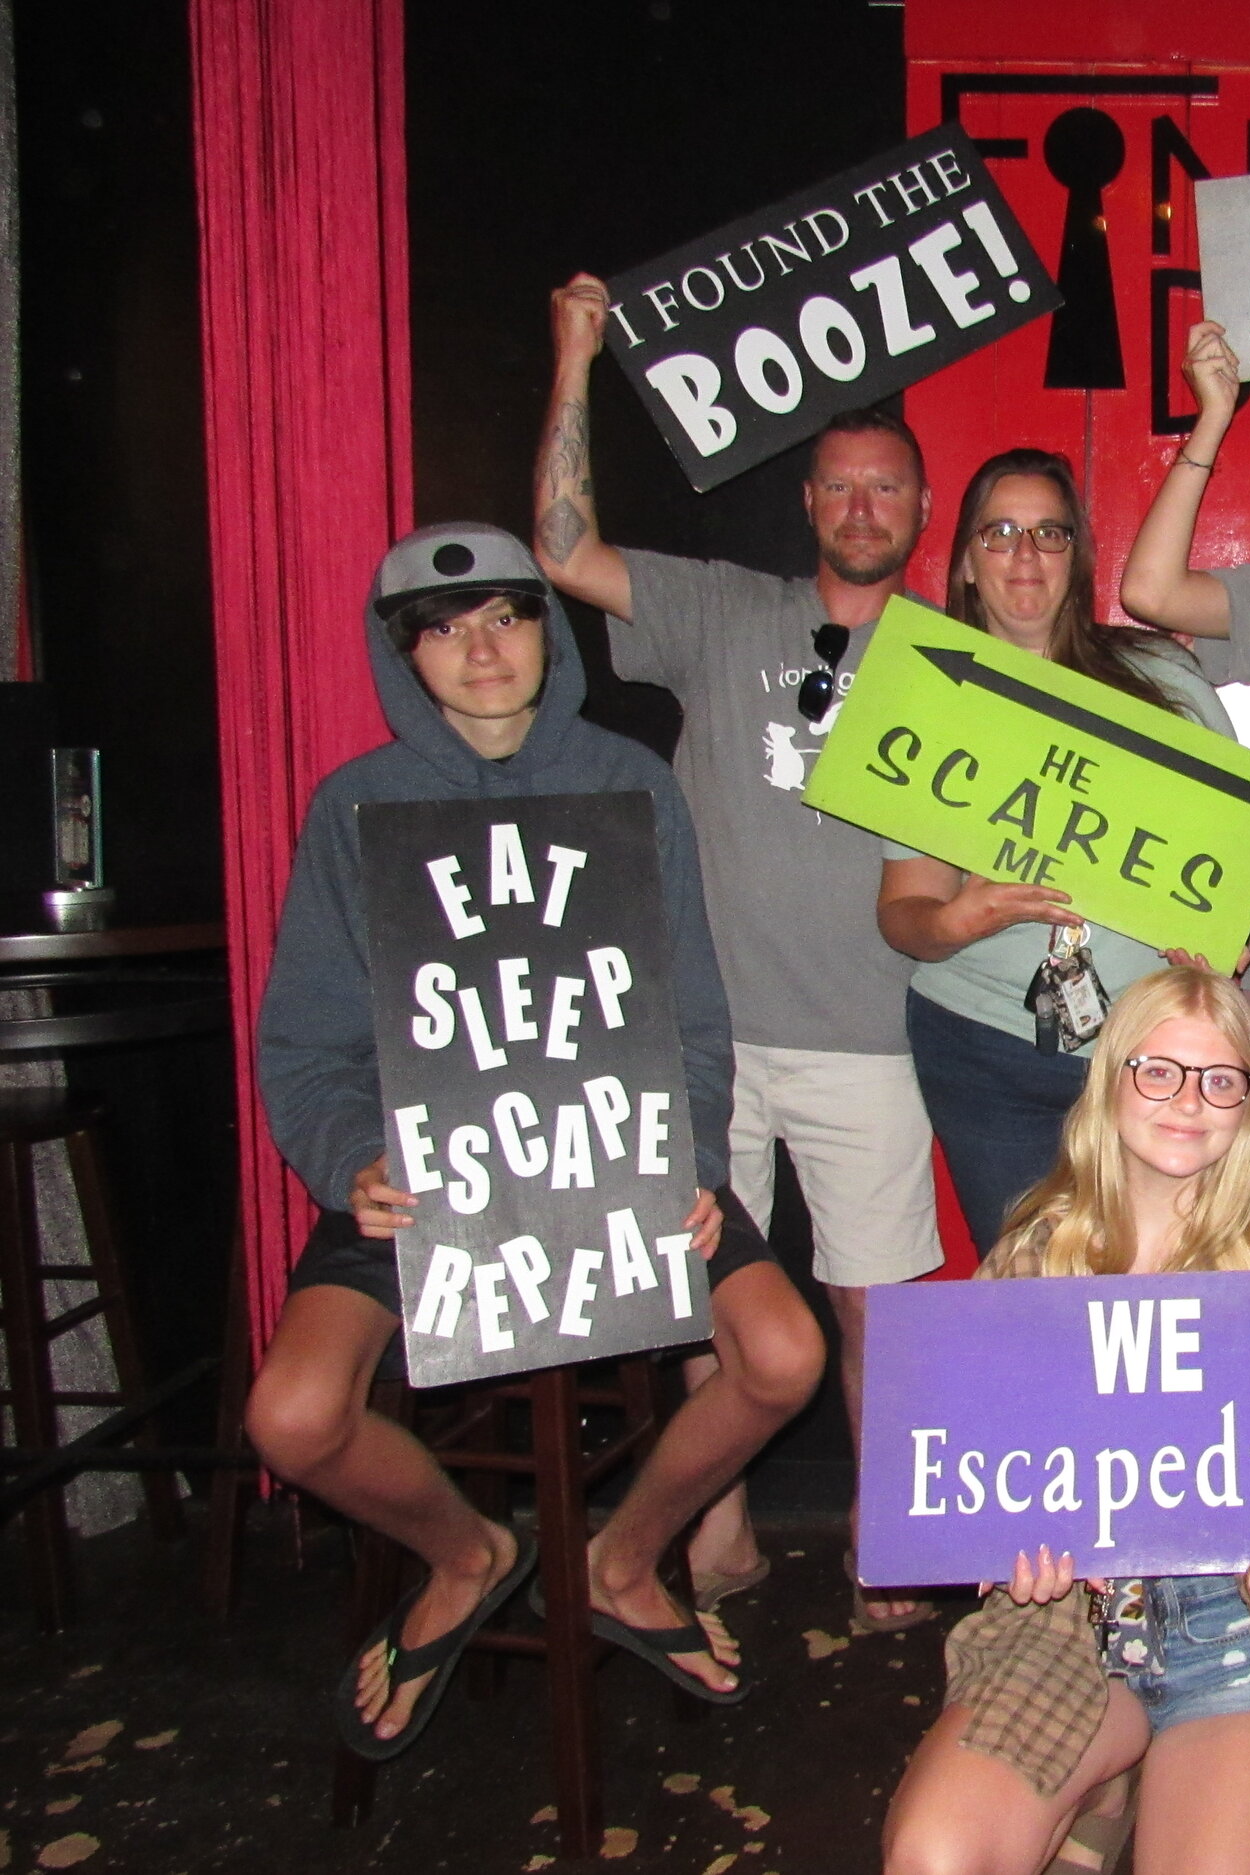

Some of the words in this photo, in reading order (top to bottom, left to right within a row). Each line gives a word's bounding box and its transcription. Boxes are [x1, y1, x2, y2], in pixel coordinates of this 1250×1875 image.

[608, 302, 645, 349] I
[642, 207, 850, 332] FOUND
[854, 148, 972, 229] THE
[645, 200, 1031, 458] BOOZE!
[865, 725, 1224, 914] SCARES
[1038, 743, 1101, 795] HE
[426, 823, 588, 940] EAT
[992, 837, 1065, 886] ME
[411, 946, 633, 1071] SLEEP
[394, 1074, 670, 1215] ESCAPE
[411, 1207, 693, 1354] REPEAT
[1086, 1297, 1204, 1395] WE
